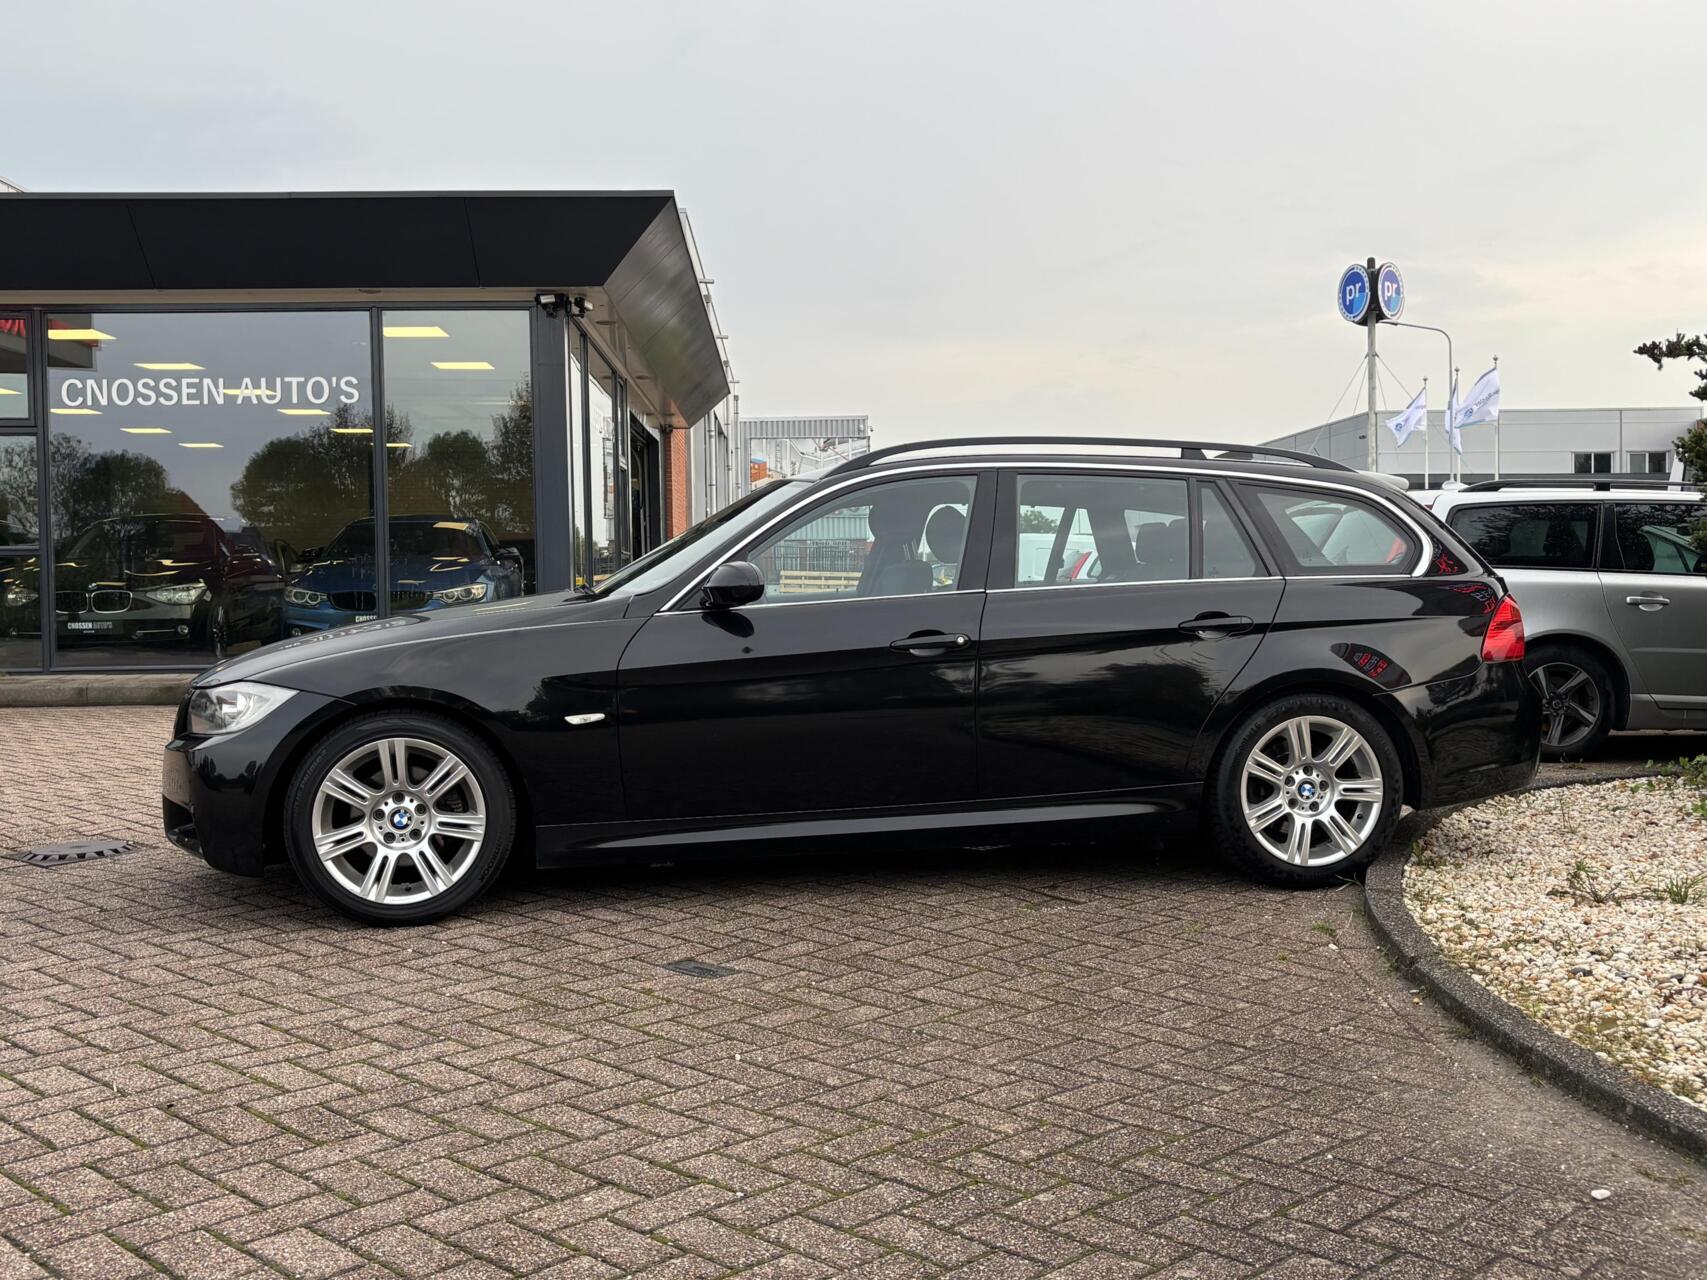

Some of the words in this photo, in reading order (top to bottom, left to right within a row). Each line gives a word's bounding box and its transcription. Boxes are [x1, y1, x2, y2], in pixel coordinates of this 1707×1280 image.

[1346, 282, 1362, 306] pr
[1384, 281, 1398, 301] pr
[60, 377, 224, 407] CNOSSEN
[236, 375, 360, 405] AUTO'S
